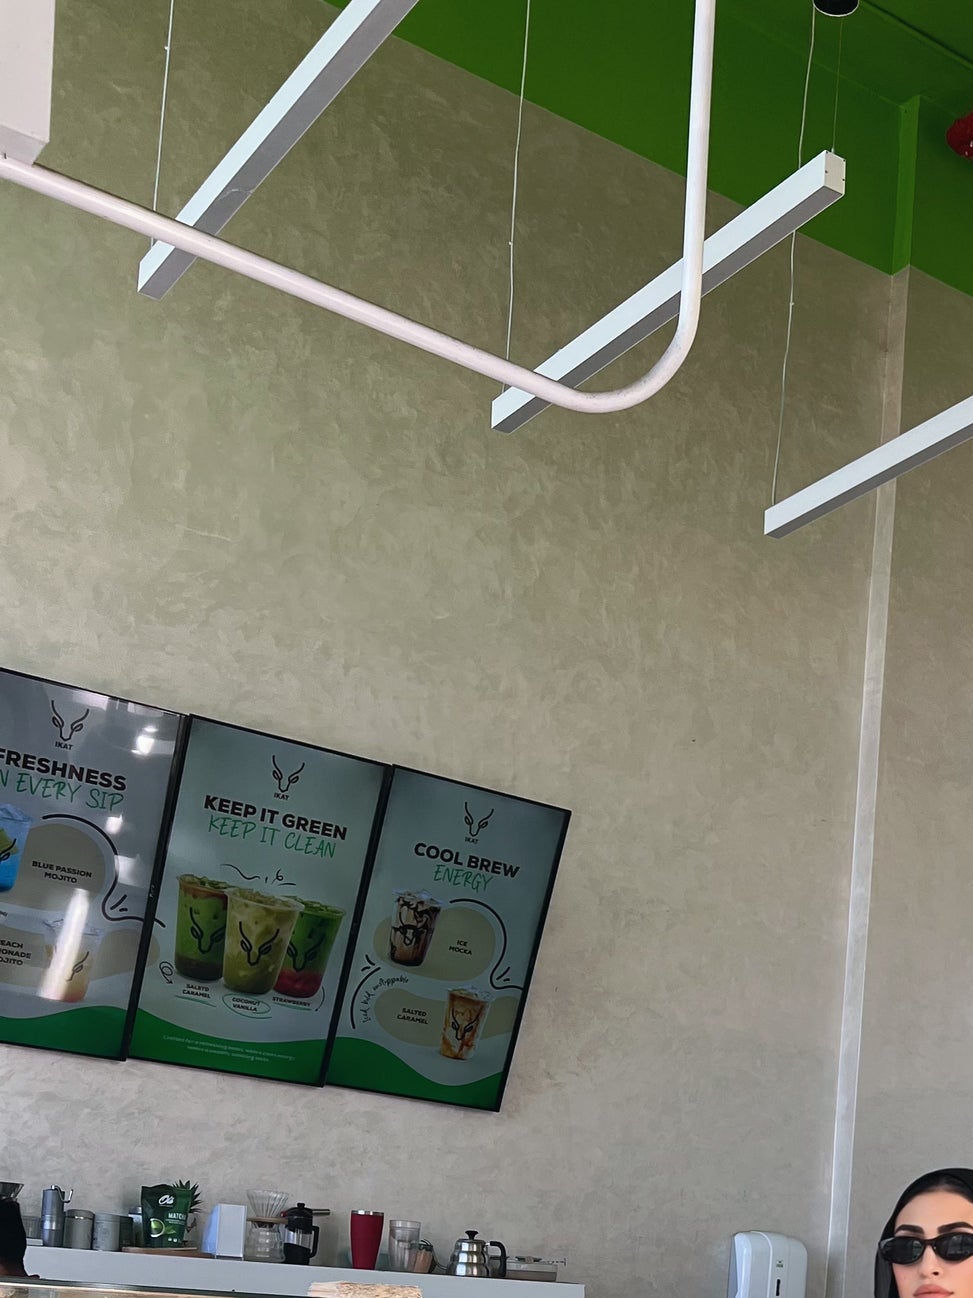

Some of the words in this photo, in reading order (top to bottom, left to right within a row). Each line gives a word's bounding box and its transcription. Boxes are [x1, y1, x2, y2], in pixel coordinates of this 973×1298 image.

[55, 741, 73, 750] IKAT
[16, 772, 82, 803] EVERY
[85, 788, 124, 811] SIP
[274, 792, 290, 801] IKAT
[204, 794, 257, 818] KEEP
[260, 808, 279, 824] IT
[282, 813, 348, 841] GREEN
[208, 814, 256, 839] KEEP
[260, 827, 280, 846] IT
[284, 831, 336, 858] CLEAN
[414, 842, 463, 866] COOL
[467, 855, 520, 878] BREW
[32, 860, 54, 871] BLUE
[55, 865, 92, 878] PASSION
[44, 872, 77, 884] MOJITO
[433, 864, 494, 893] ENERGY
[456, 939, 468, 947] ICE
[182, 989, 211, 999] CARAMEL
[272, 996, 311, 1007] STRAWBERRY
[232, 1003, 257, 1012] VANILLA
[402, 1007, 427, 1017] SALTED
[397, 1014, 428, 1025] CARAMEL
